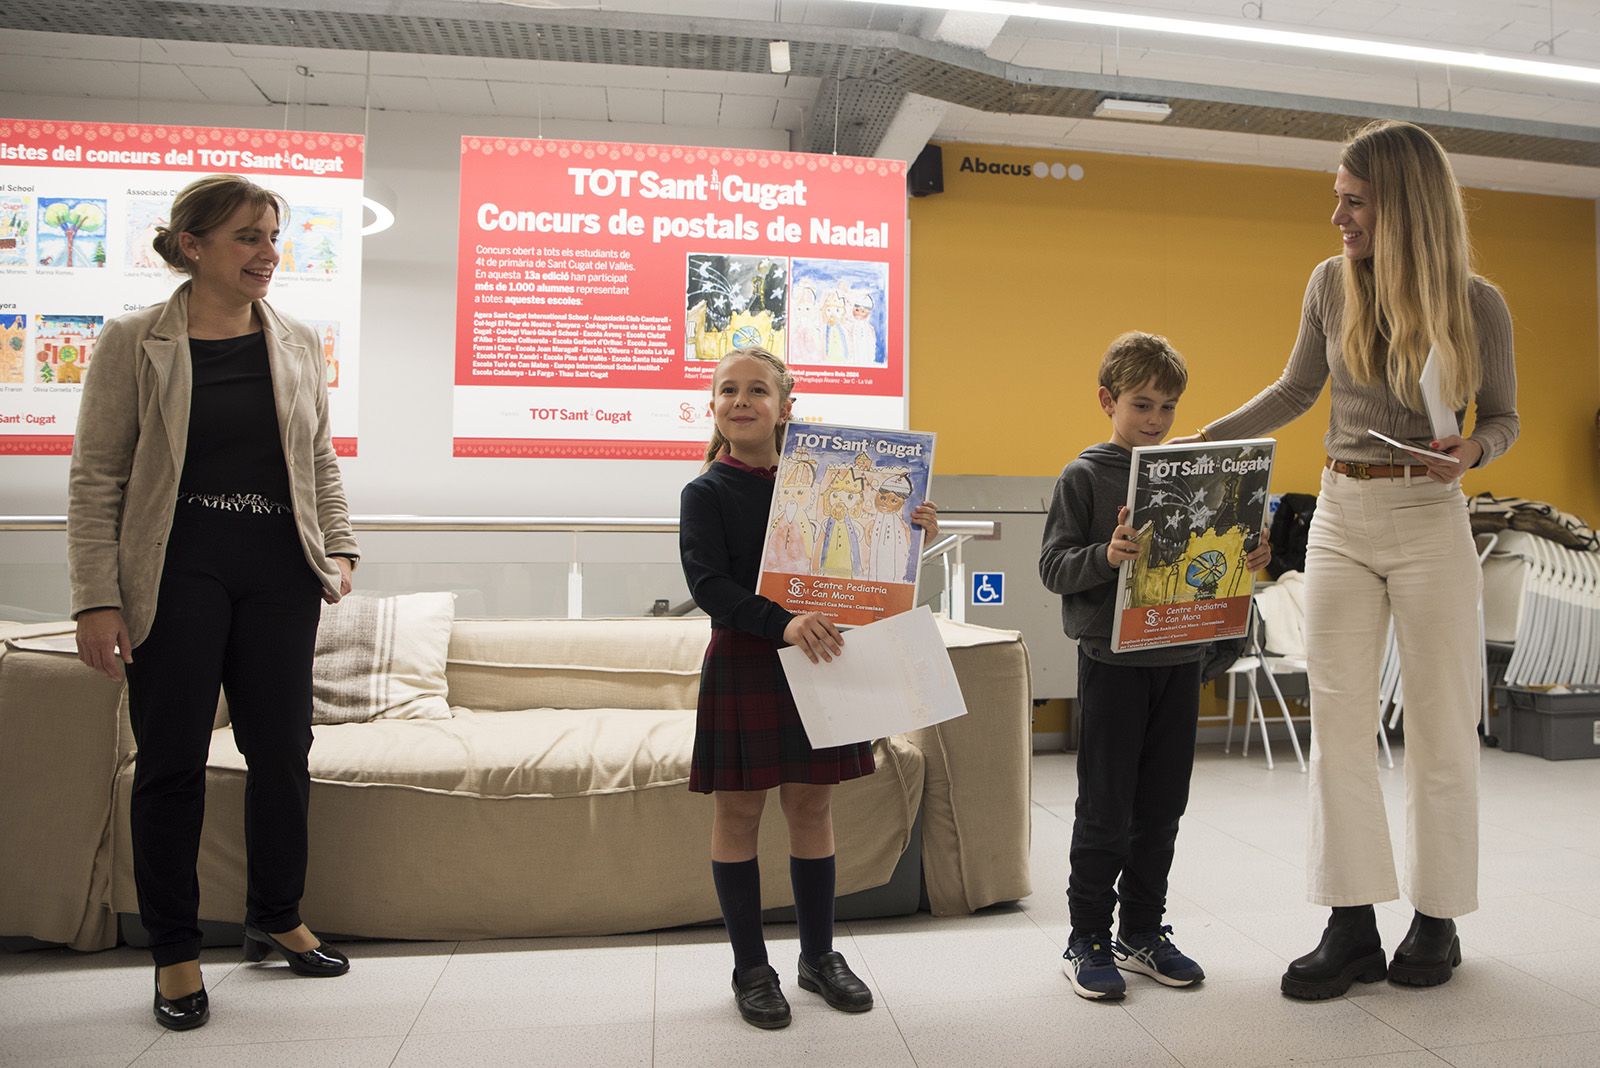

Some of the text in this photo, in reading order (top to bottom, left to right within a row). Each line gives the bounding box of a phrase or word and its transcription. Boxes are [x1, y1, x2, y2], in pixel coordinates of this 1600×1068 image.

[52, 145, 82, 162] del
[86, 149, 161, 165] concurs
[165, 149, 193, 166] del
[197, 149, 240, 167] TOT
[240, 150, 283, 169] Sant
[290, 153, 344, 174] Cugat
[960, 156, 1031, 176] Abacus
[567, 167, 807, 210] TOT Sant Cugat
[477, 203, 888, 248] Concurs de postals de Nadal
[476, 245, 630, 259] Concurs obert a tots els estudiants de
[476, 258, 486, 266] 4t
[486, 258, 497, 267] de
[498, 259, 534, 270] primària
[536, 260, 546, 268] de
[548, 260, 567, 269] Sant
[568, 260, 593, 271] Cugat
[594, 261, 608, 270] del
[476, 270, 627, 284] En aquesta 13a edició han participat
[475, 282, 629, 296] més de 1.000 alumnes representant
[482, 294, 503, 304] totes
[504, 295, 545, 306] aquestes
[547, 296, 584, 306] escoles:
[26, 414, 56, 425] Cugat
[529, 408, 558, 420] TOT
[560, 409, 588, 421] Sant
[595, 410, 632, 424] Cugat
[795, 434, 922, 458] TOT Sant Cugat
[1146, 461, 1180, 478] TOT
[1181, 460, 1214, 475] Sant
[813, 580, 843, 591] Centre
[812, 590, 854, 600] Can Mora
[1166, 606, 1192, 615] Centre
